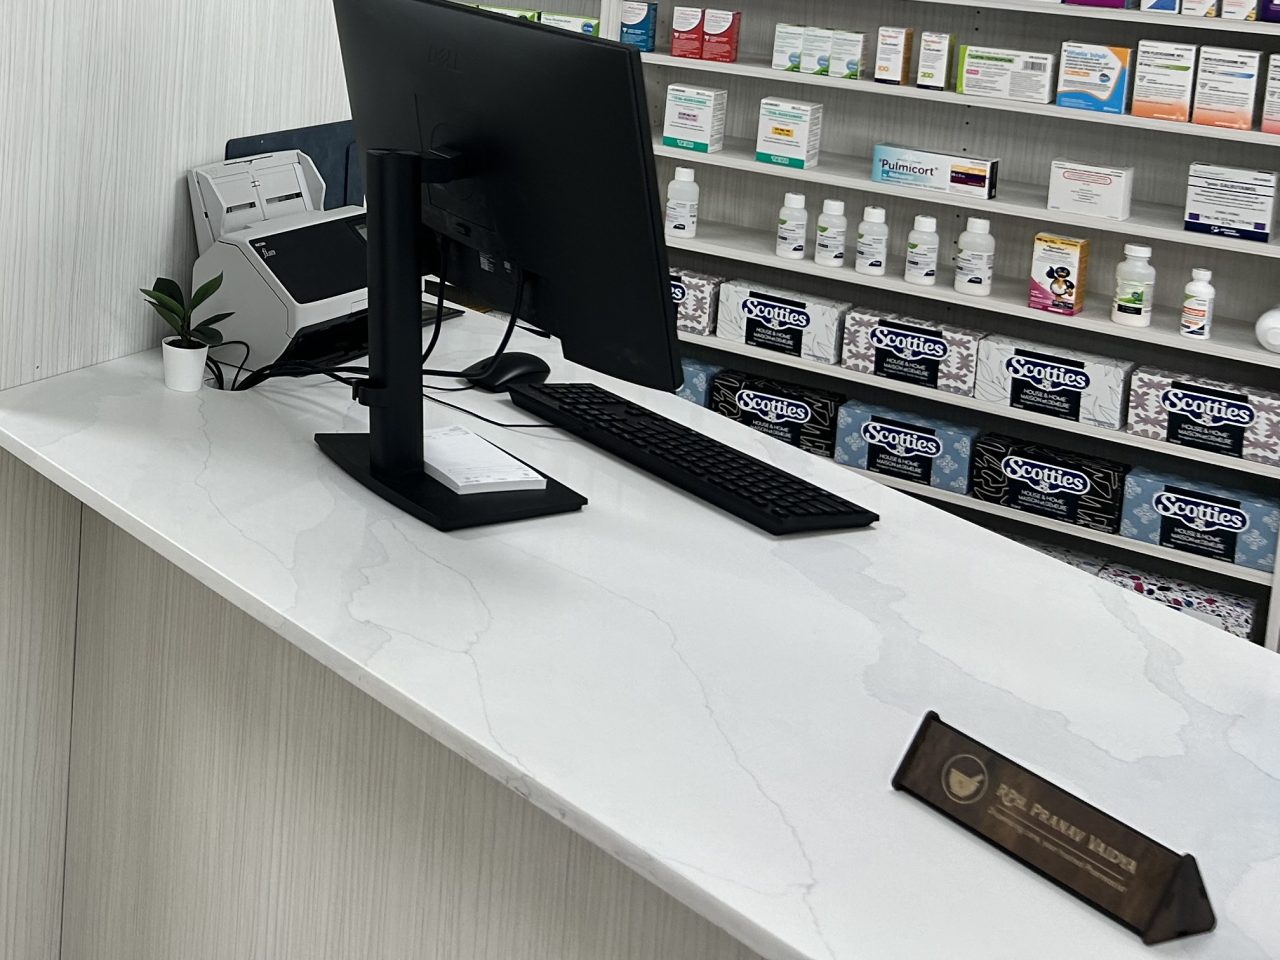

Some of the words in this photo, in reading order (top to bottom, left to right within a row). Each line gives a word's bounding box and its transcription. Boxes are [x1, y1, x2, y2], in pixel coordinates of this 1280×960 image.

[882, 159, 934, 177] Pulmicort
[744, 300, 808, 324] Scotties
[873, 328, 945, 356] Scotties
[1008, 358, 1088, 388] Scotties
[738, 392, 807, 418] Scotties
[1164, 391, 1252, 423] Scotties
[864, 424, 938, 453] Scotties
[1004, 458, 1087, 490] Scotties
[1155, 493, 1247, 528] Scotties
